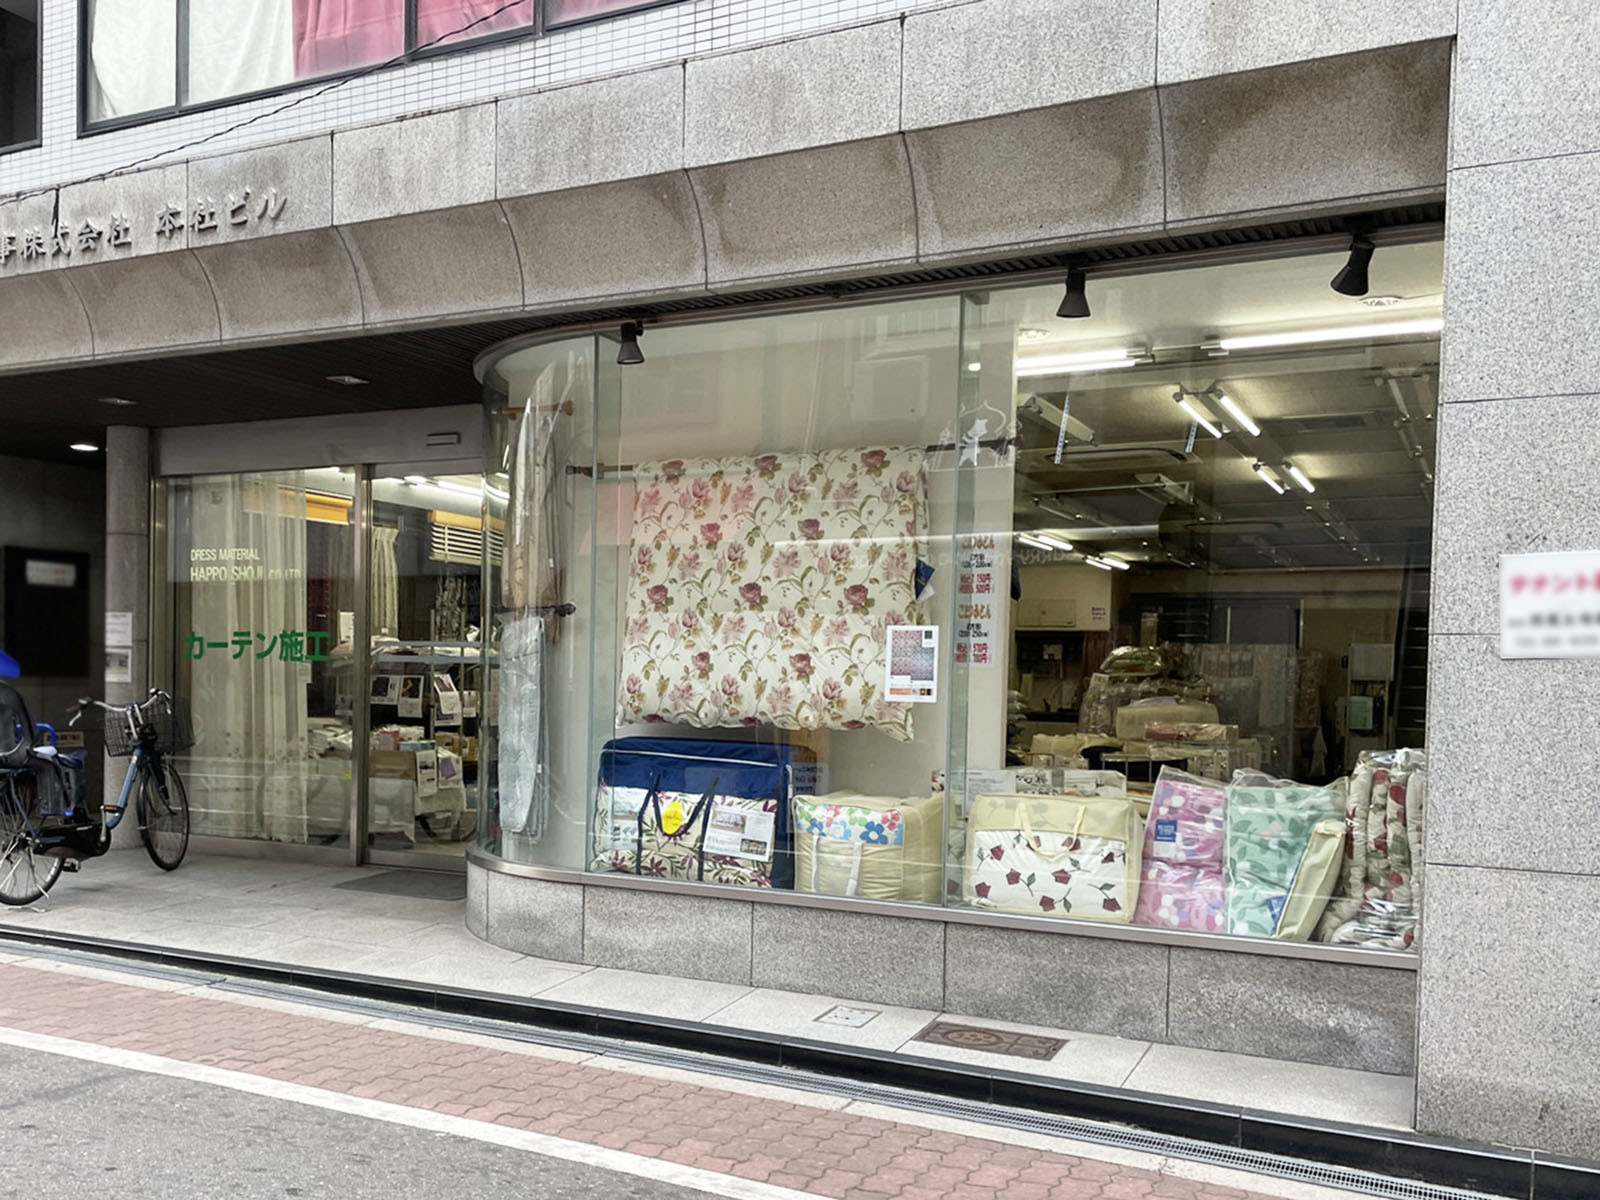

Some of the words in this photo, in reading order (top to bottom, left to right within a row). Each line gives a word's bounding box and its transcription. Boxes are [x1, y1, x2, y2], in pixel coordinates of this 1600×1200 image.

[155, 187, 288, 238] 本社ビル
[190, 548, 217, 561] DRESS
[218, 547, 260, 561] MATERIAL
[190, 566, 228, 582] HAPPO
[184, 629, 329, 662] カーテン施工
